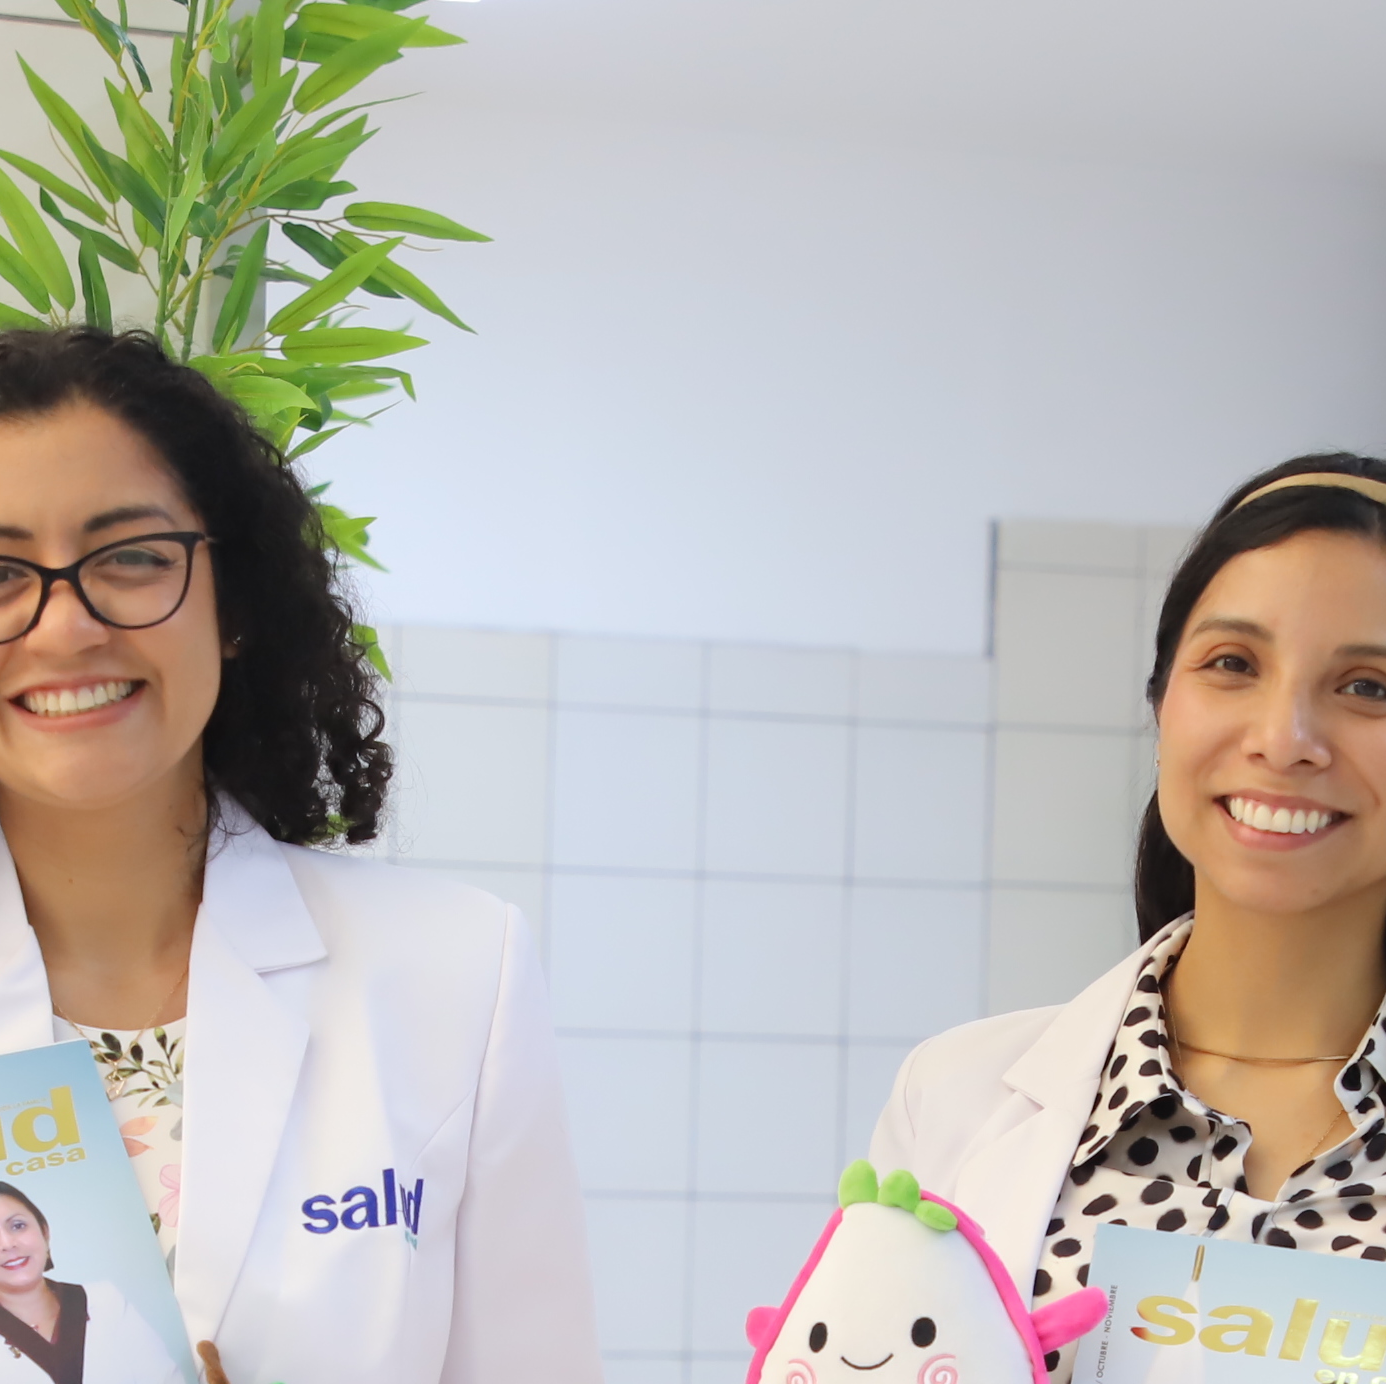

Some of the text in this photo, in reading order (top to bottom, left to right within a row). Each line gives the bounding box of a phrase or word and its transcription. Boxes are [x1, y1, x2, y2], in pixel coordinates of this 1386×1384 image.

[5, 1147, 86, 1177] casa
[1096, 1340, 1108, 1378] OCTUBRE
[1104, 1285, 1118, 1333] NOVIEMBRE
